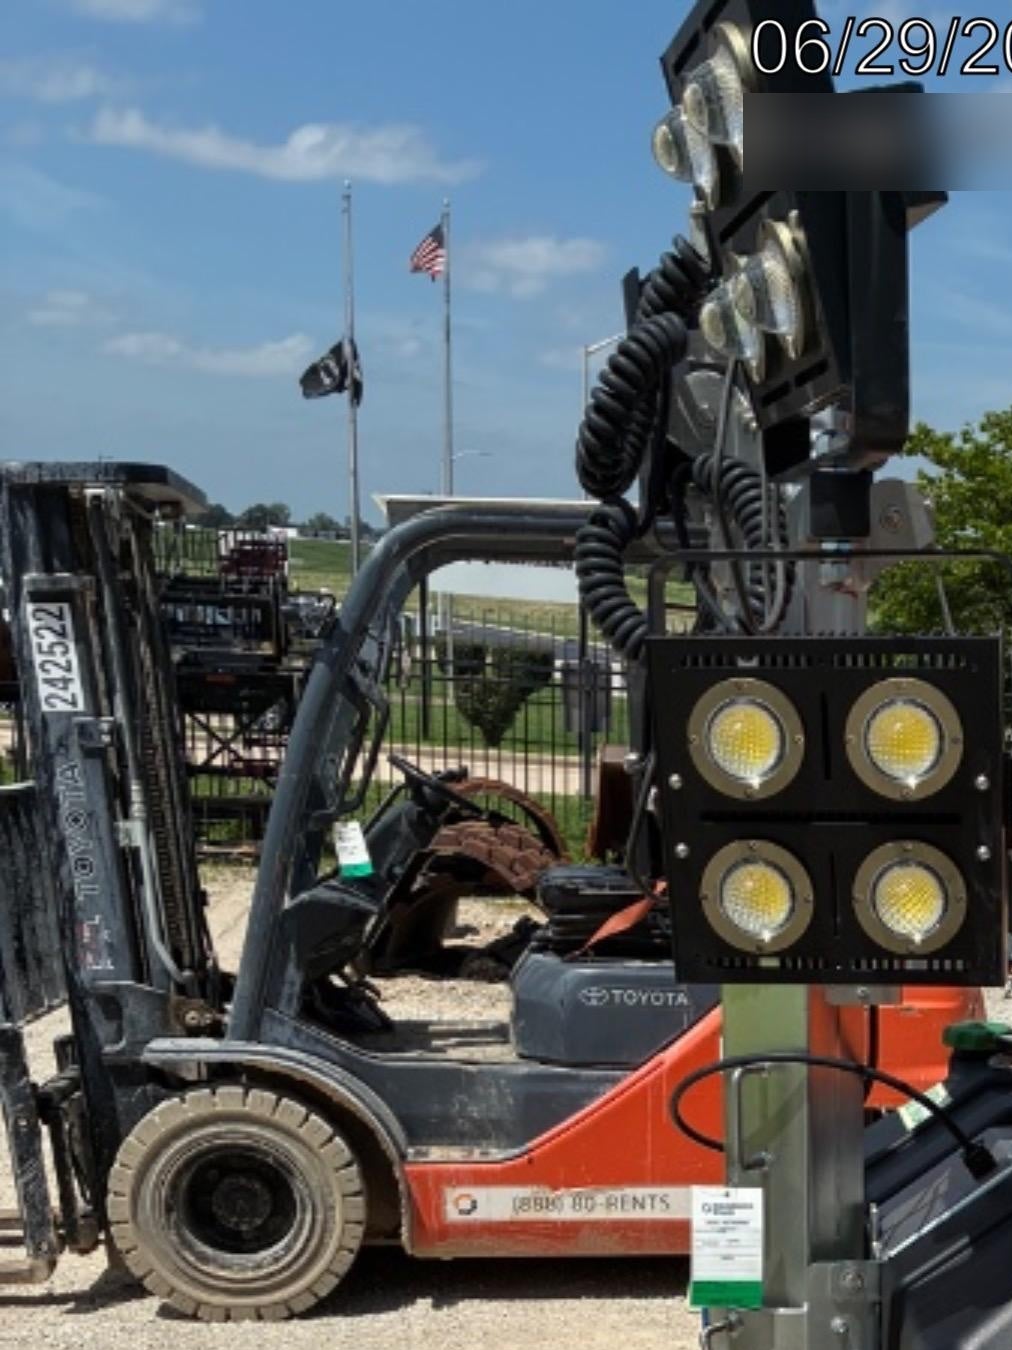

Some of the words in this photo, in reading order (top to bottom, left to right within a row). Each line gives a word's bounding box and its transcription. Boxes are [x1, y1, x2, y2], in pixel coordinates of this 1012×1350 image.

[32, 605, 79, 709] 242522
[56, 760, 99, 902] TOYOTA
[611, 988, 689, 1007] TOYOTA
